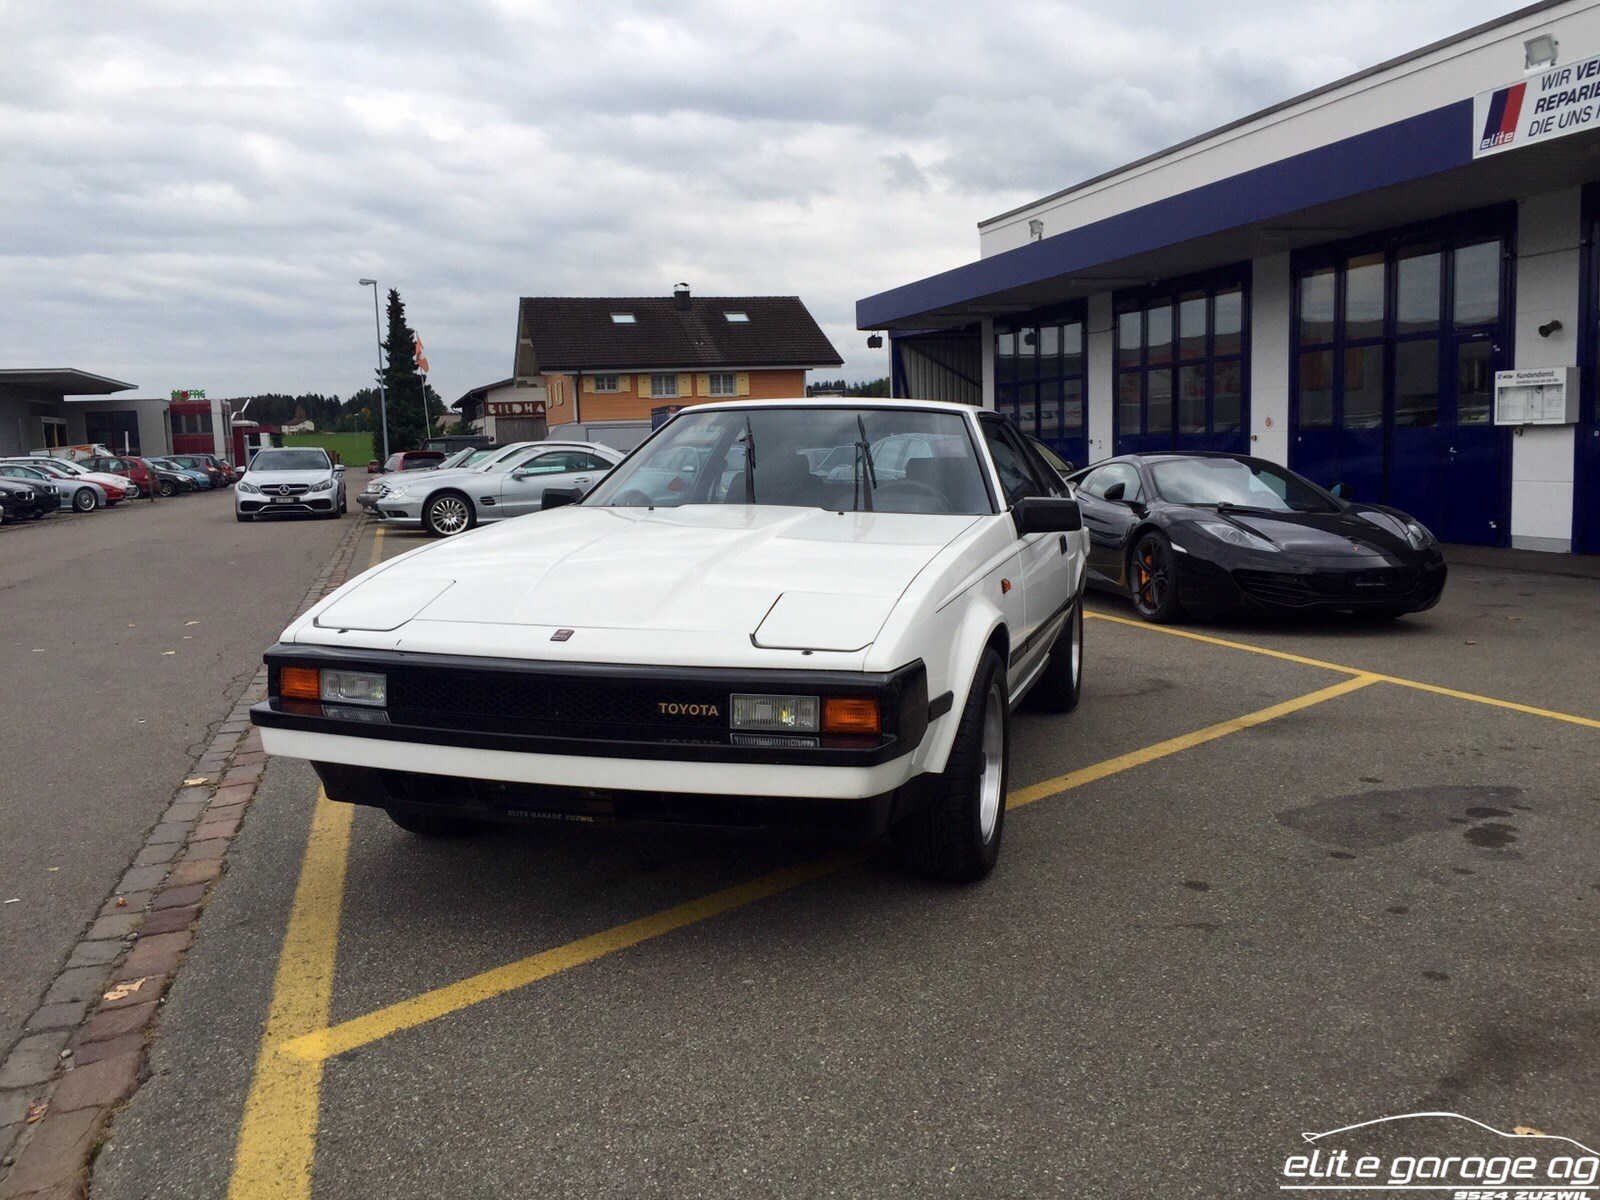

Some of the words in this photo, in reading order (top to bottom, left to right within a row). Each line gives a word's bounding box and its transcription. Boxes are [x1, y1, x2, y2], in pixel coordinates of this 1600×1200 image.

[1541, 68, 1571, 91] WIR
[1576, 59, 1600, 81] VE
[1528, 115, 1556, 137] DIE
[1558, 105, 1593, 129] UNS
[1480, 131, 1514, 149] elite
[658, 702, 719, 716] TOYOTA
